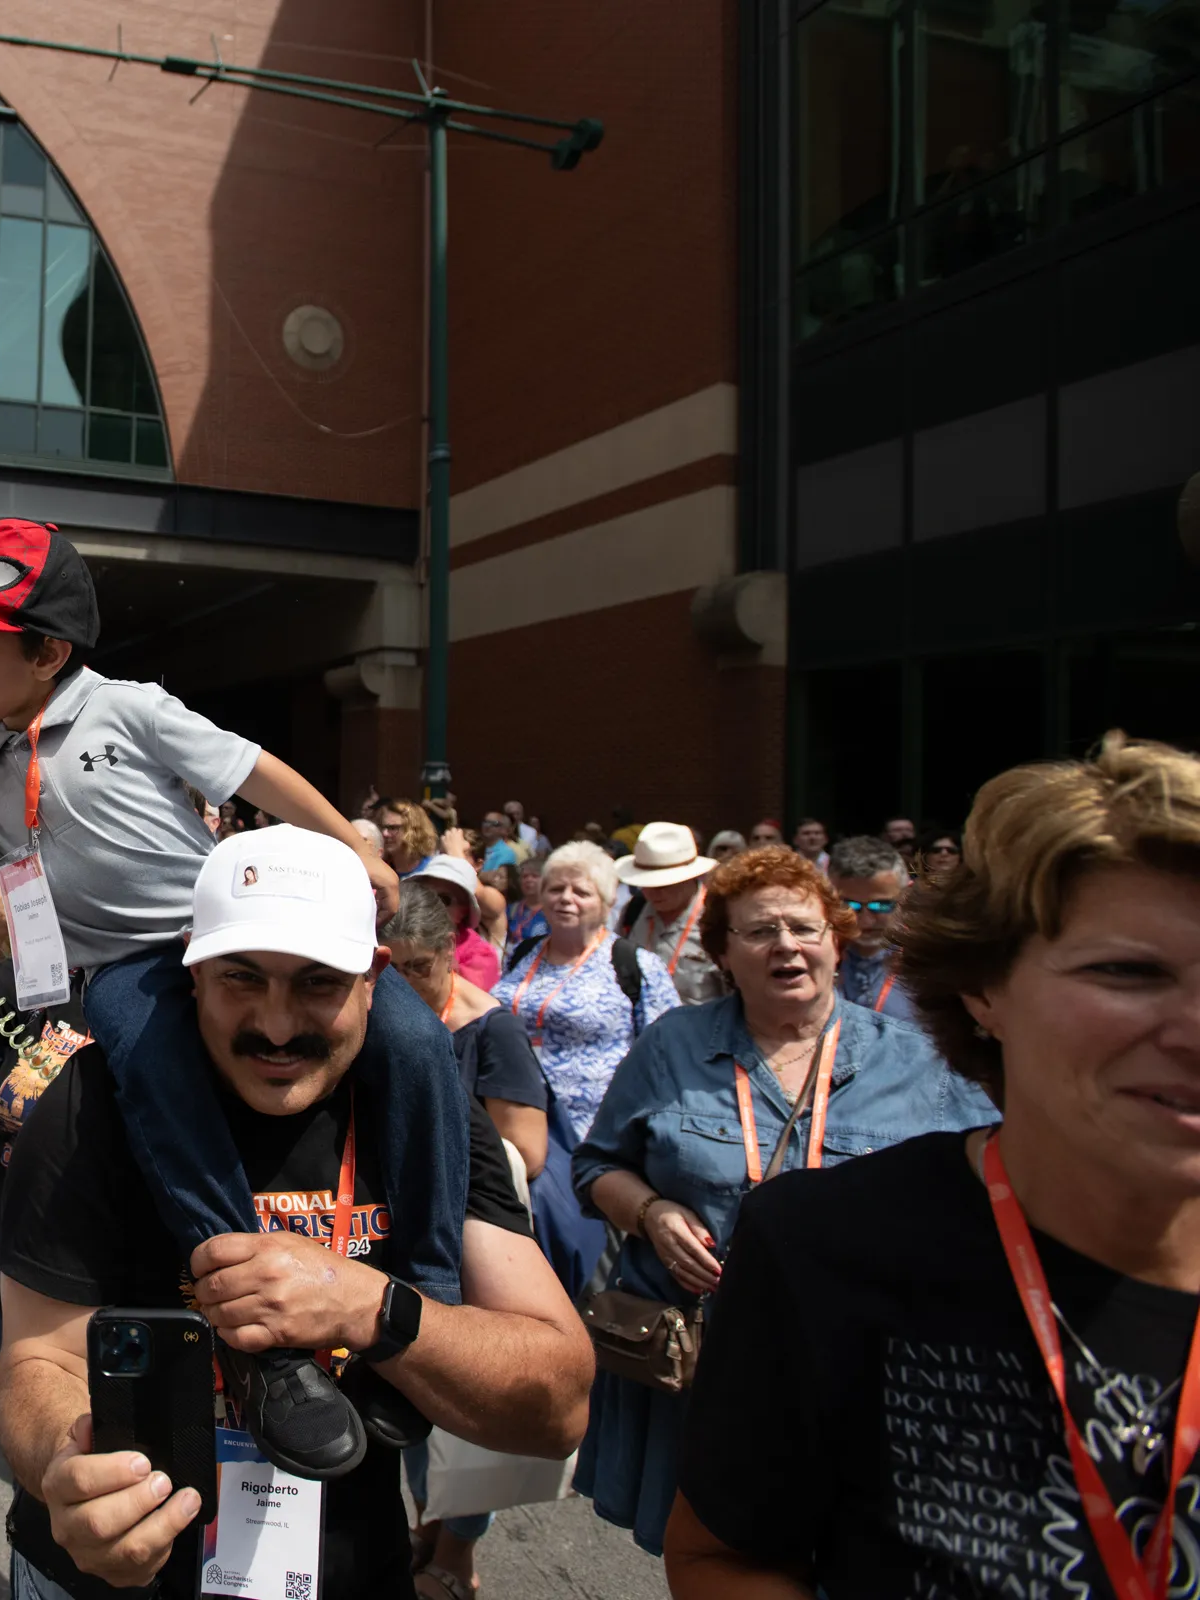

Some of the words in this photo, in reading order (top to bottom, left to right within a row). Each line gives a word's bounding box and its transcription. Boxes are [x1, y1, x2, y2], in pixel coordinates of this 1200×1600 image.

[13, 900, 31, 914] Tobias
[30, 895, 48, 909] Joseph
[254, 1194, 337, 1212] TIONAL
[337, 1236, 345, 1256] ress
[223, 1439, 258, 1449] ENCUENTR
[241, 1481, 299, 1496] Rigoberto
[256, 1499, 282, 1509] Jaime
[245, 1517, 283, 1529] Streamwood,
[284, 1521, 290, 1529] IL
[223, 1574, 254, 1584] Eucharistic
[223, 1580, 249, 1589] Congress
